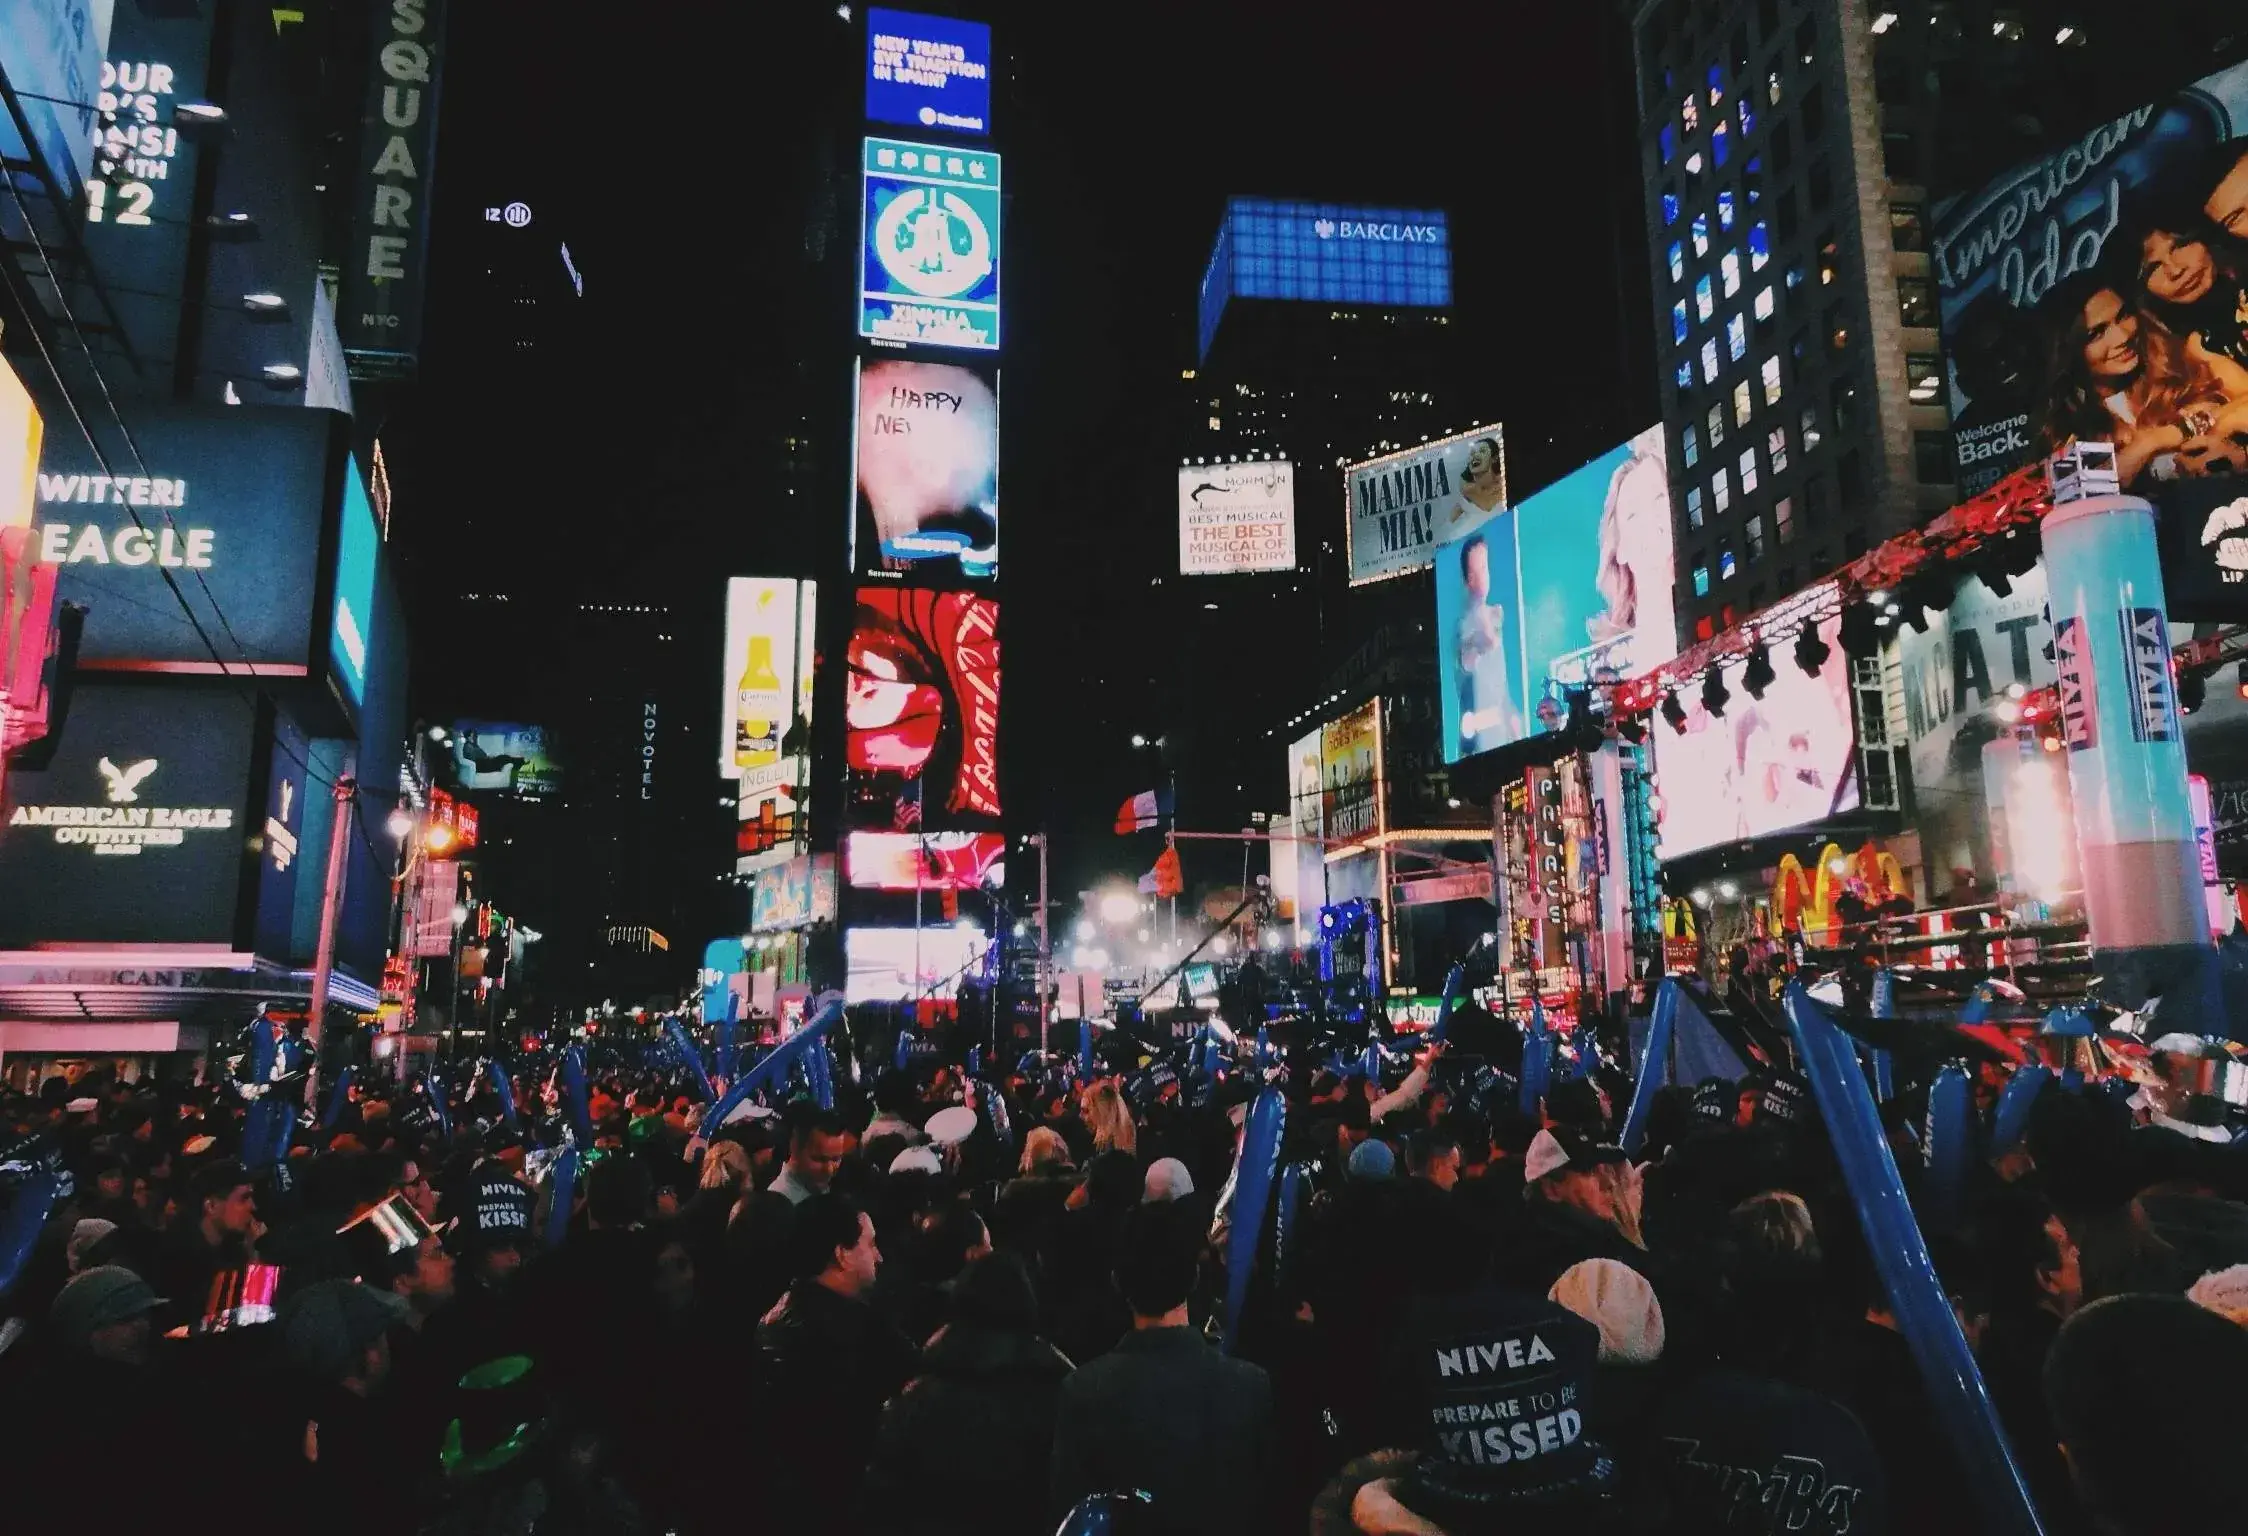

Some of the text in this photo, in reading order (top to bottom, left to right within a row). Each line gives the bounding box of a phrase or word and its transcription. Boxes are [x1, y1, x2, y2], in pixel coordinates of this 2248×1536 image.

[367, 0, 430, 280] SQUARE
[1339, 220, 1437, 244] BARCLAYS
[2001, 177, 2119, 308] Idol
[890, 386, 962, 414] HAPPY
[1955, 414, 2028, 445] Welcome
[1958, 429, 2030, 465] Back.
[38, 473, 186, 507] WITTER!
[1359, 458, 1451, 519] MAMMA
[1190, 523, 1286, 541] THE BEST
[1226, 511, 1286, 521] MUSICAL
[1379, 502, 1434, 554] MIA!
[40, 523, 215, 568] EAGLE
[1189, 537, 1288, 554] MUSICAL OF
[2222, 571, 2245, 583] LIP
[2058, 624, 2088, 743] NIVEA
[2134, 615, 2169, 741] NIVEA
[641, 703, 657, 800] NOVOTEL
[9, 807, 233, 828] AMERICAN EAGLE
[1541, 779, 1561, 924] PALACE
[481, 1183, 527, 1196] NIVEA
[1436, 1334, 1556, 1377] NIVEA
[1433, 1399, 1521, 1425] PREPARE
[1528, 1392, 1555, 1412] TO
[1439, 1408, 1582, 1465] KISSED
